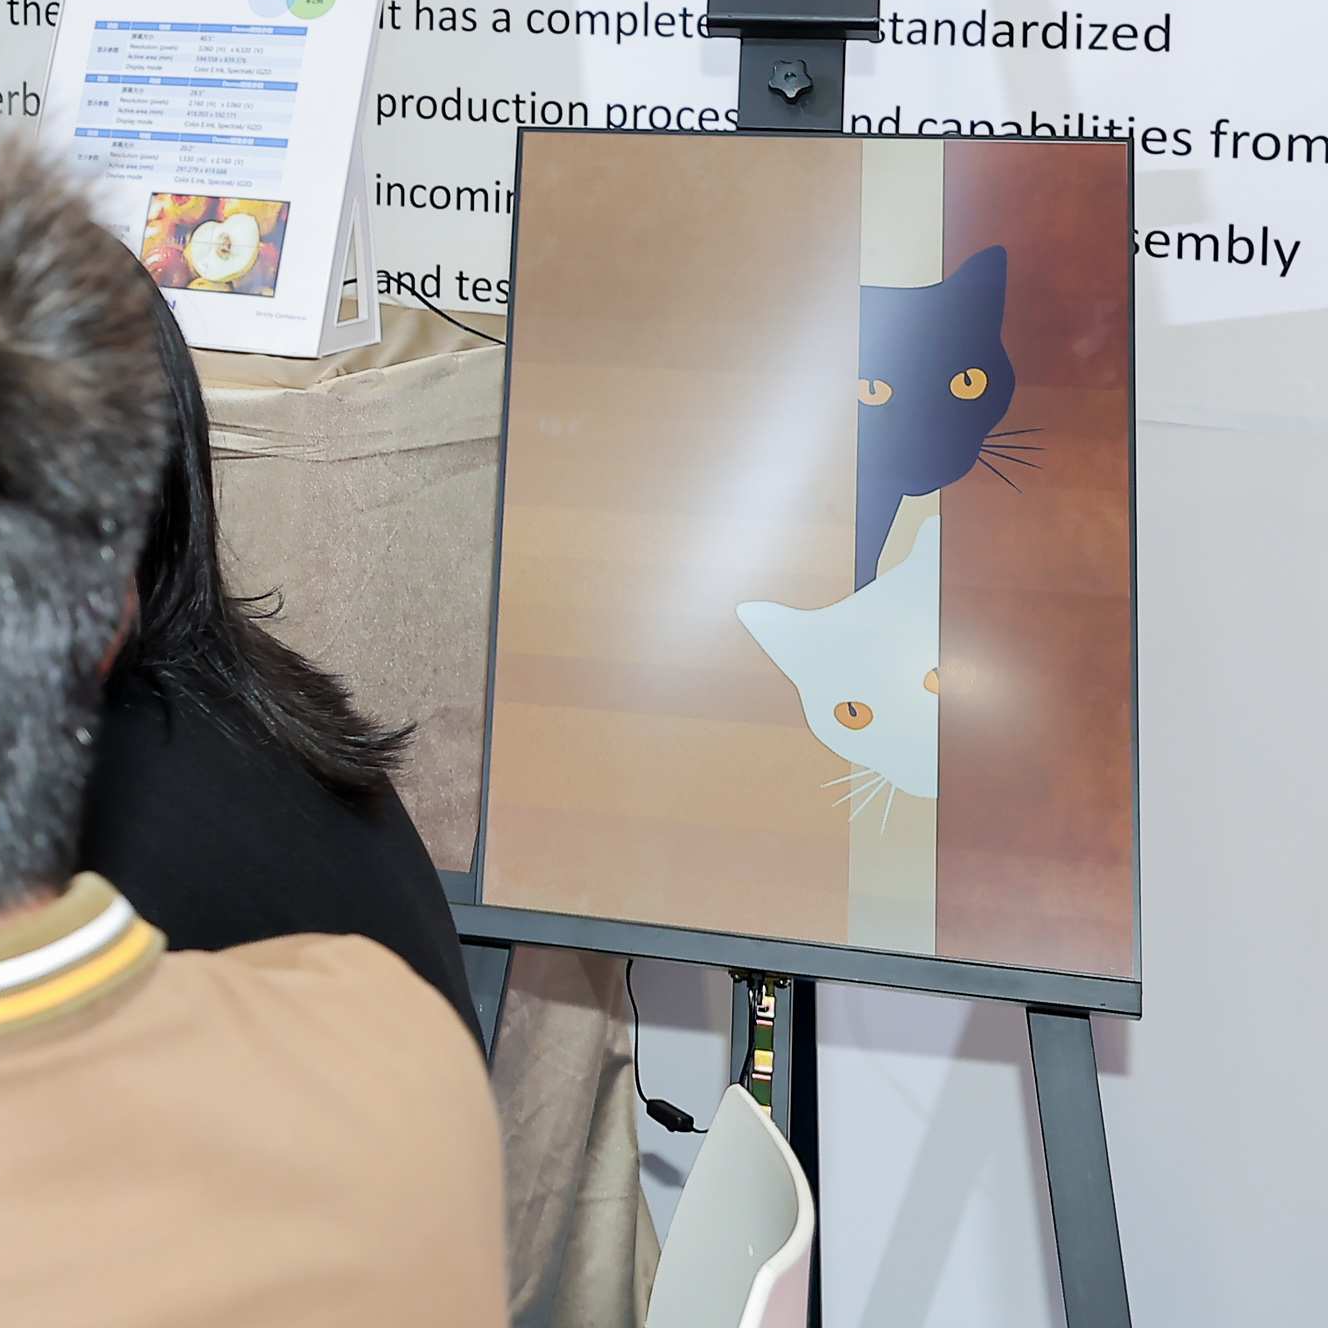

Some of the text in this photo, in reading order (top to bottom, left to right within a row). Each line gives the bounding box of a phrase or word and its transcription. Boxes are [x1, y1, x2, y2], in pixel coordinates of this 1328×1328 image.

[490, 7, 512, 34] a
[526, 1, 711, 43] complete
[375, 90, 1328, 166] production from
[376, 266, 442, 301] and
